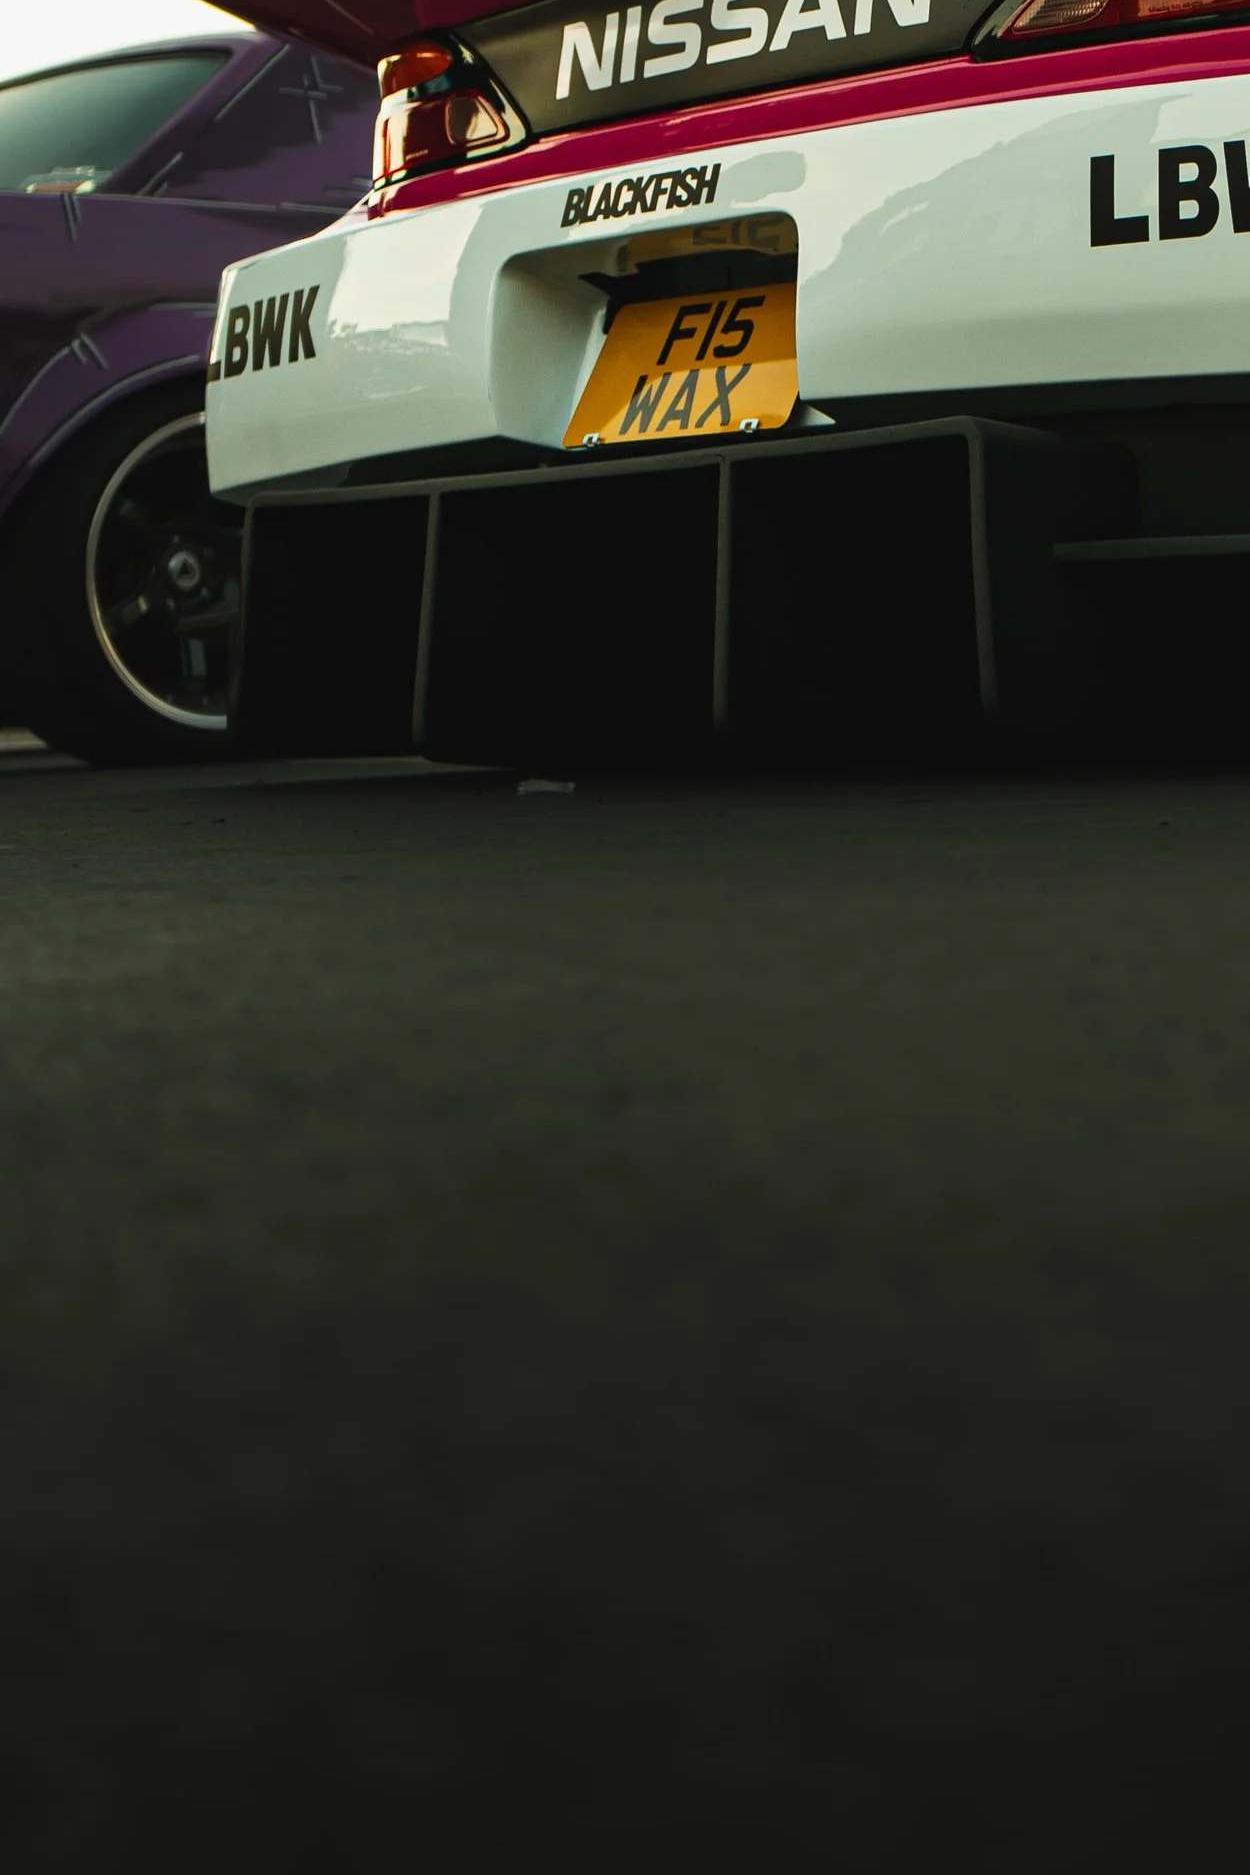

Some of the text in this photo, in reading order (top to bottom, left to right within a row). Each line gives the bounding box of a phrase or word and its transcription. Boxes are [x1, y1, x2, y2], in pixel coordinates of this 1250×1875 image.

[560, 163, 722, 228] BLACKFISH
[656, 295, 767, 367] F15
[618, 362, 753, 436] WAX
